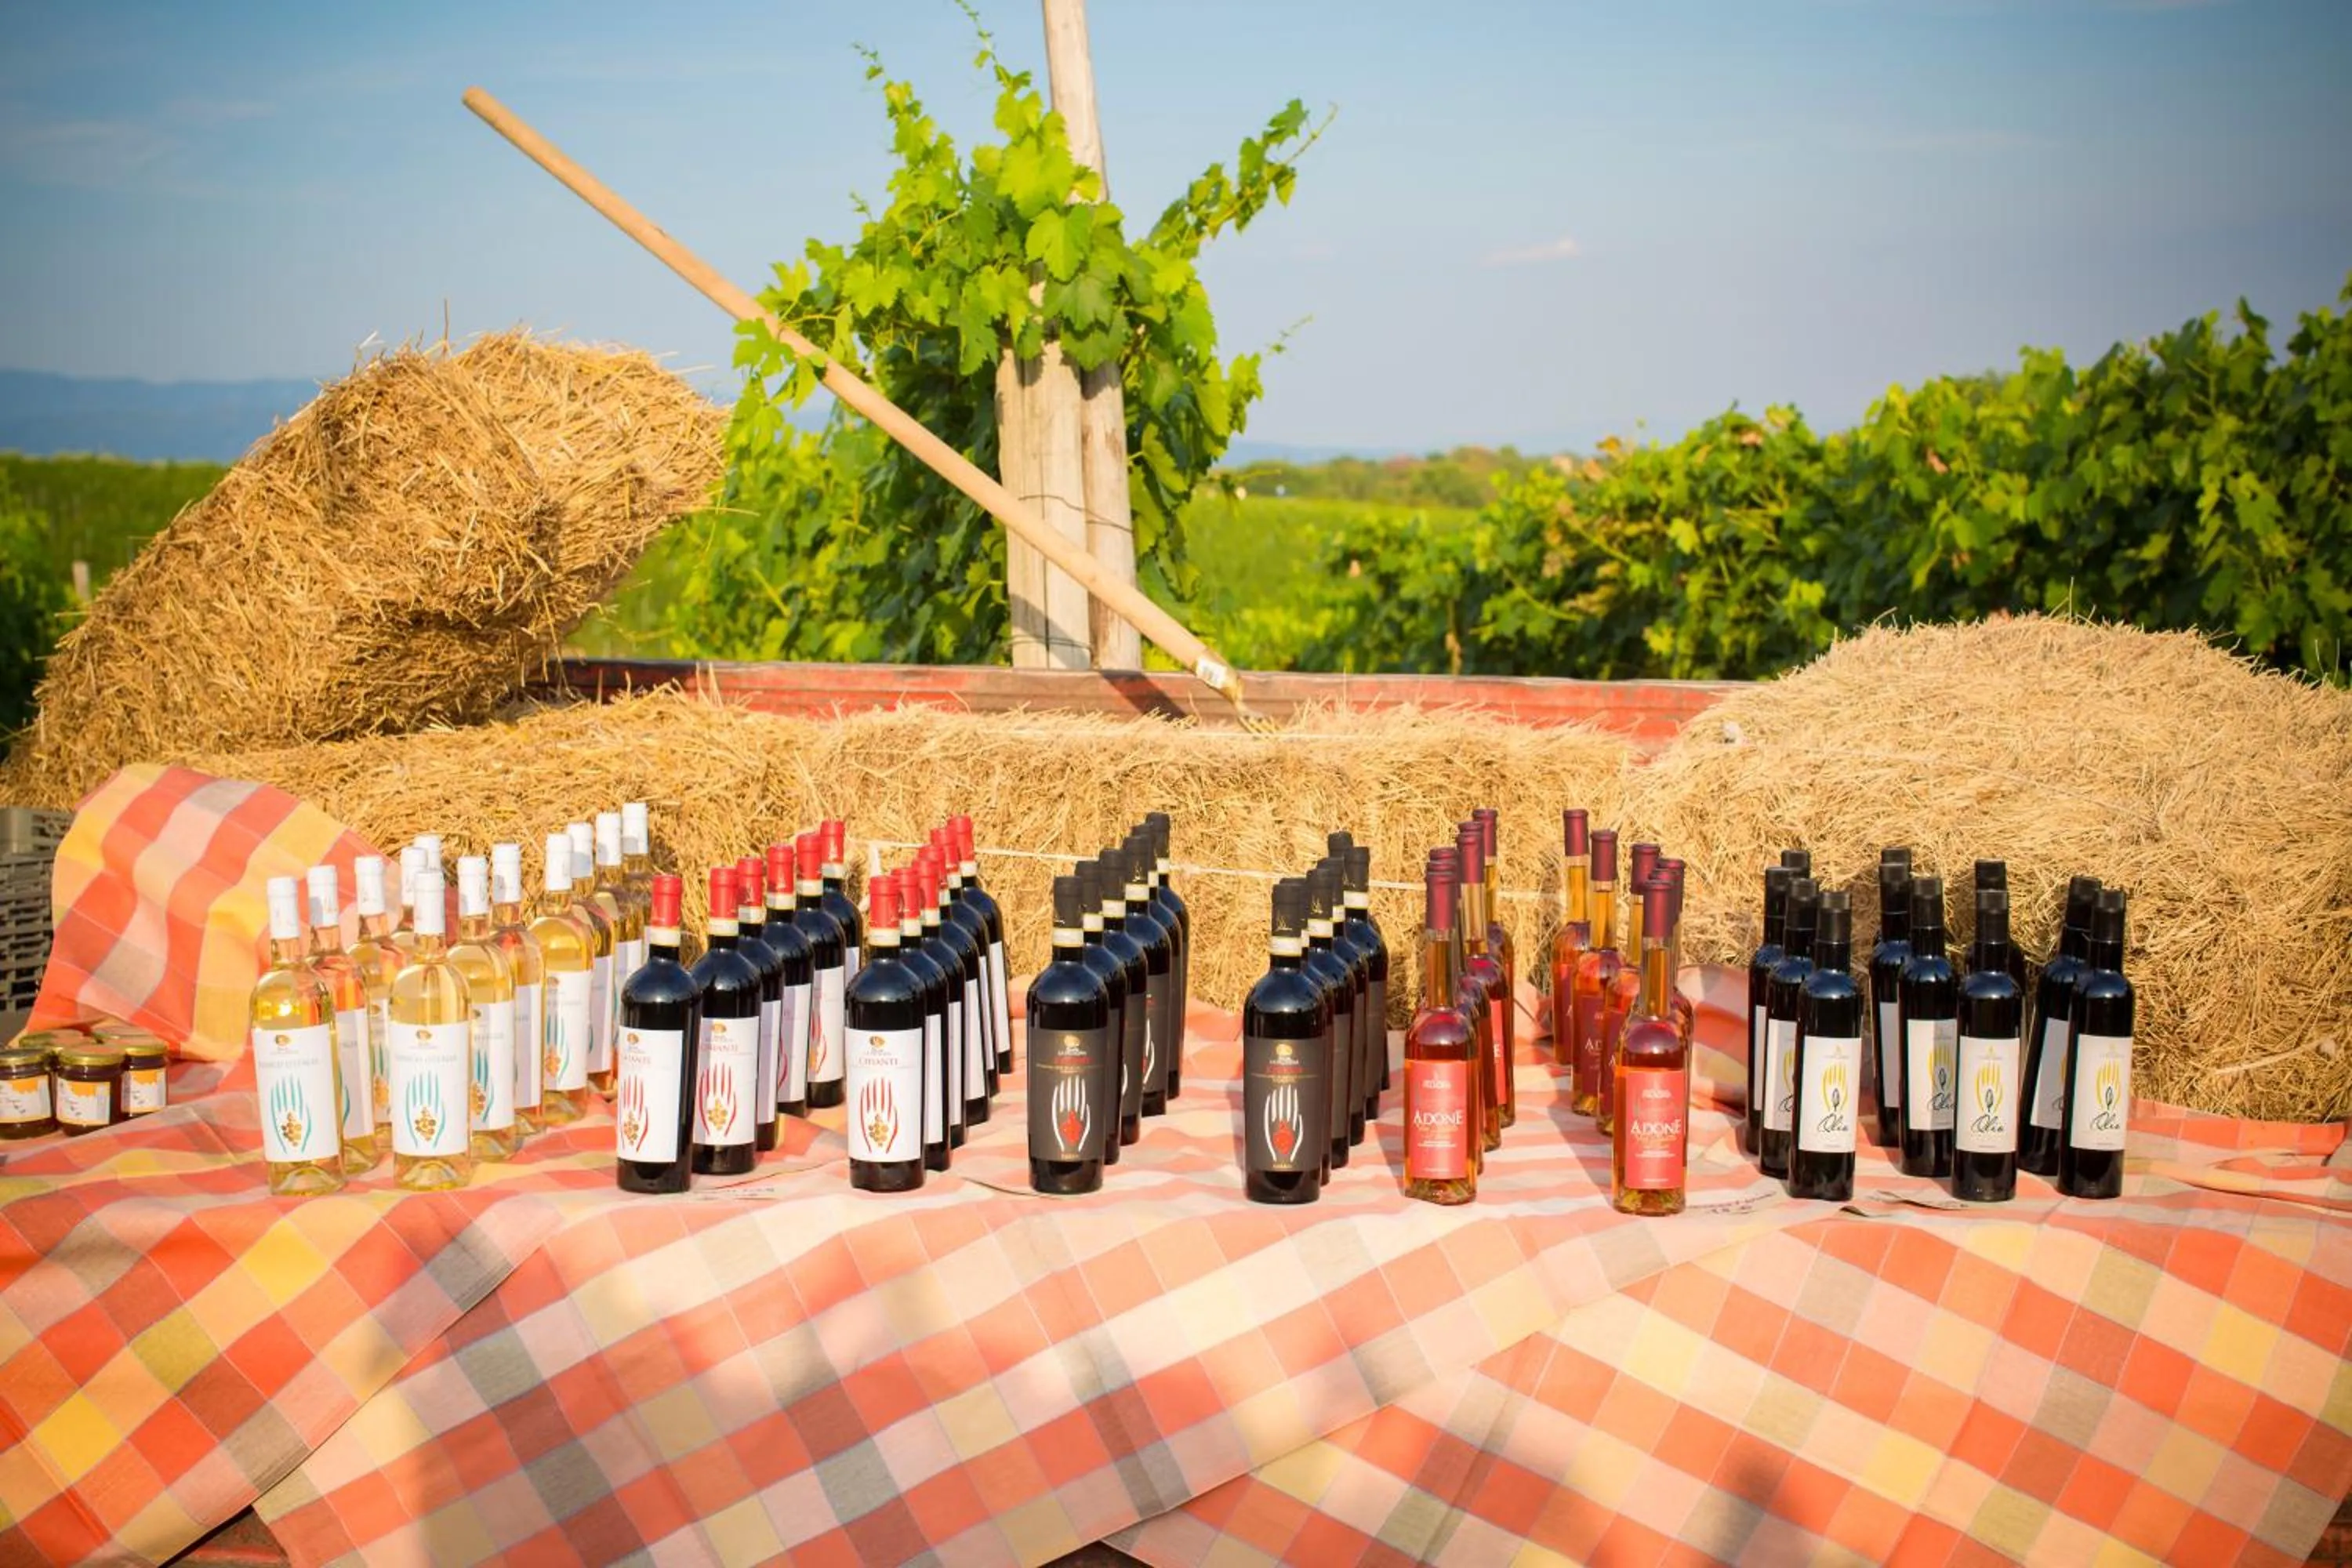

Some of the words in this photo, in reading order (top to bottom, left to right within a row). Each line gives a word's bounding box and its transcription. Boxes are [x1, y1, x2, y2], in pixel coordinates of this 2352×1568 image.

[858, 1058, 898, 1066] CHIANTI
[1414, 1109, 1464, 1125] ADONE
[1631, 1118, 1682, 1137] ADONE
